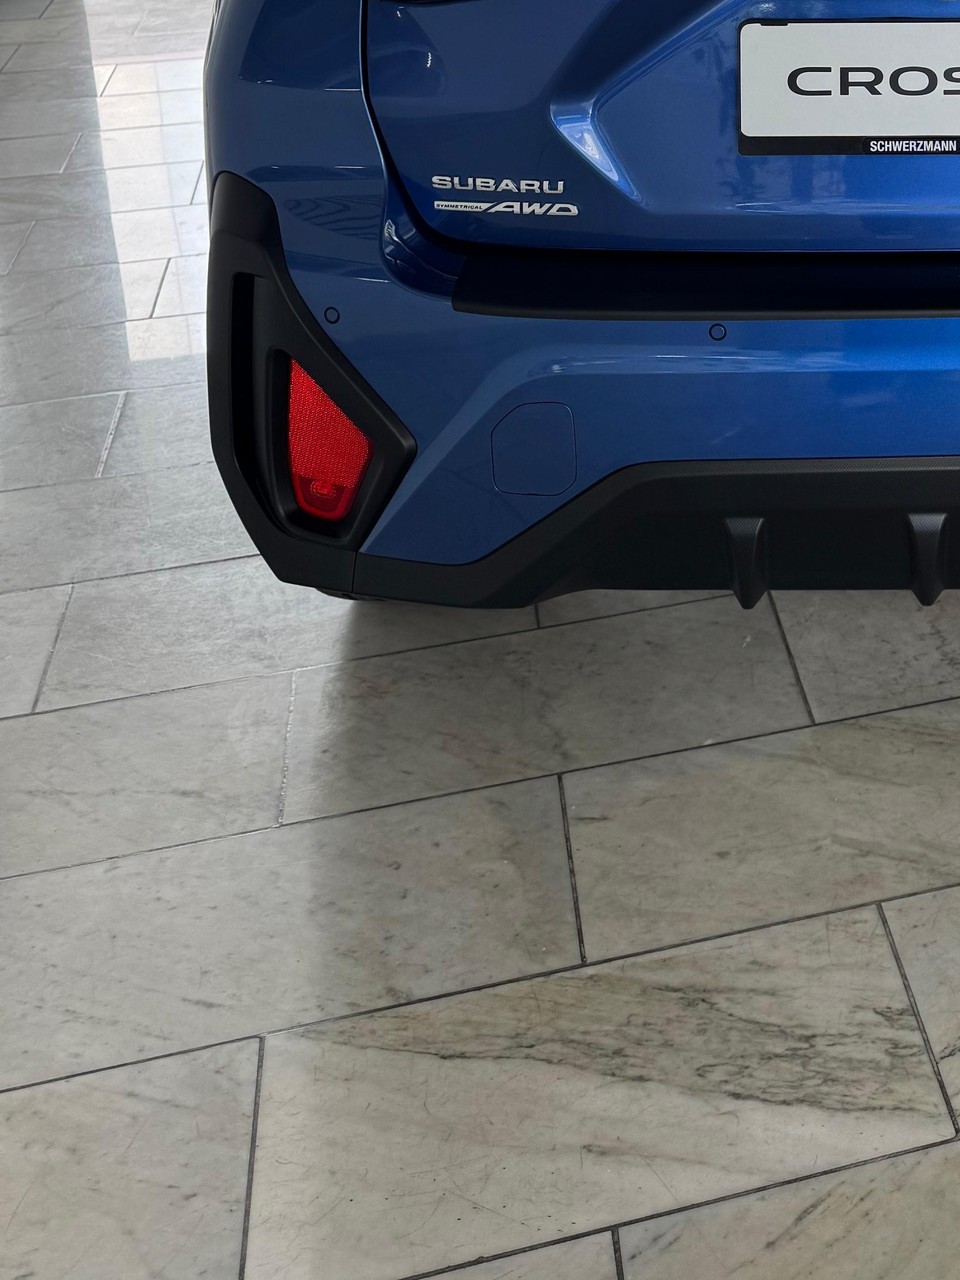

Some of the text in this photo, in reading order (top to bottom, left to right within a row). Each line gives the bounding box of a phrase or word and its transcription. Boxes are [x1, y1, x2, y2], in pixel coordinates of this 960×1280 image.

[870, 140, 956, 152] SCHWERZMANN
[431, 175, 565, 194] SUBARU
[487, 201, 579, 216] AWD
